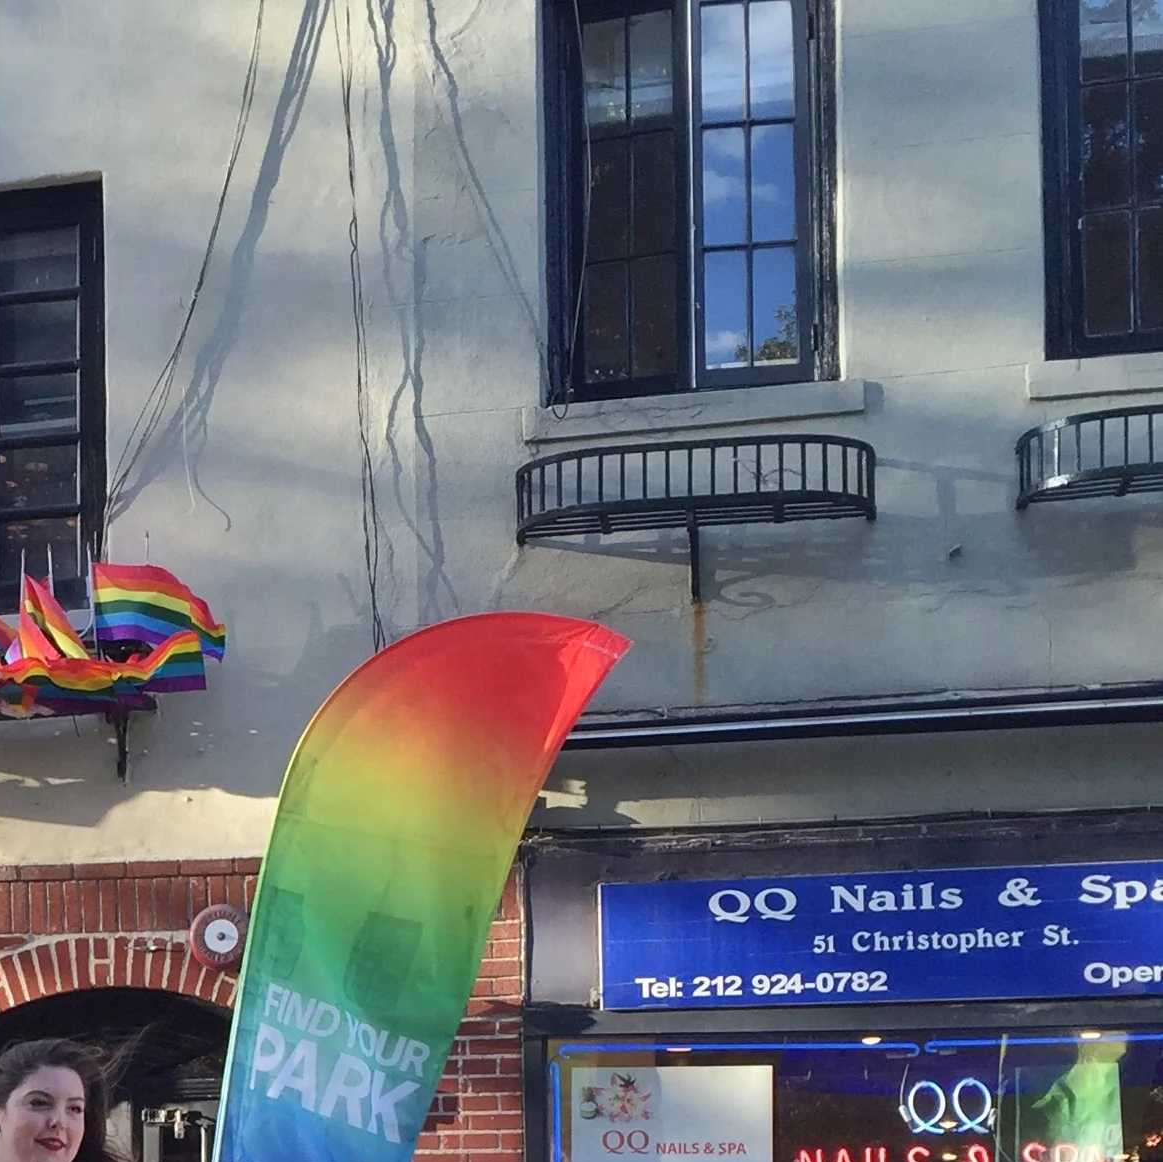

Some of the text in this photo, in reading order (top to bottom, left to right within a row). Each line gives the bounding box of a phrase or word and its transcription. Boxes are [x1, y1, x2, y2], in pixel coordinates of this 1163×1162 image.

[708, 888, 797, 923] QQ
[830, 882, 963, 914] Nails
[998, 878, 1042, 907] &
[813, 925, 1079, 954] 51 Christopher St.
[635, 971, 888, 998] Tel: 212 924-0782
[262, 982, 430, 1077] FIND YOUR
[249, 1022, 421, 1143] PARK
[907, 1077, 992, 1134] QQ
[602, 1130, 747, 1155] QQ NAILS & SPA
